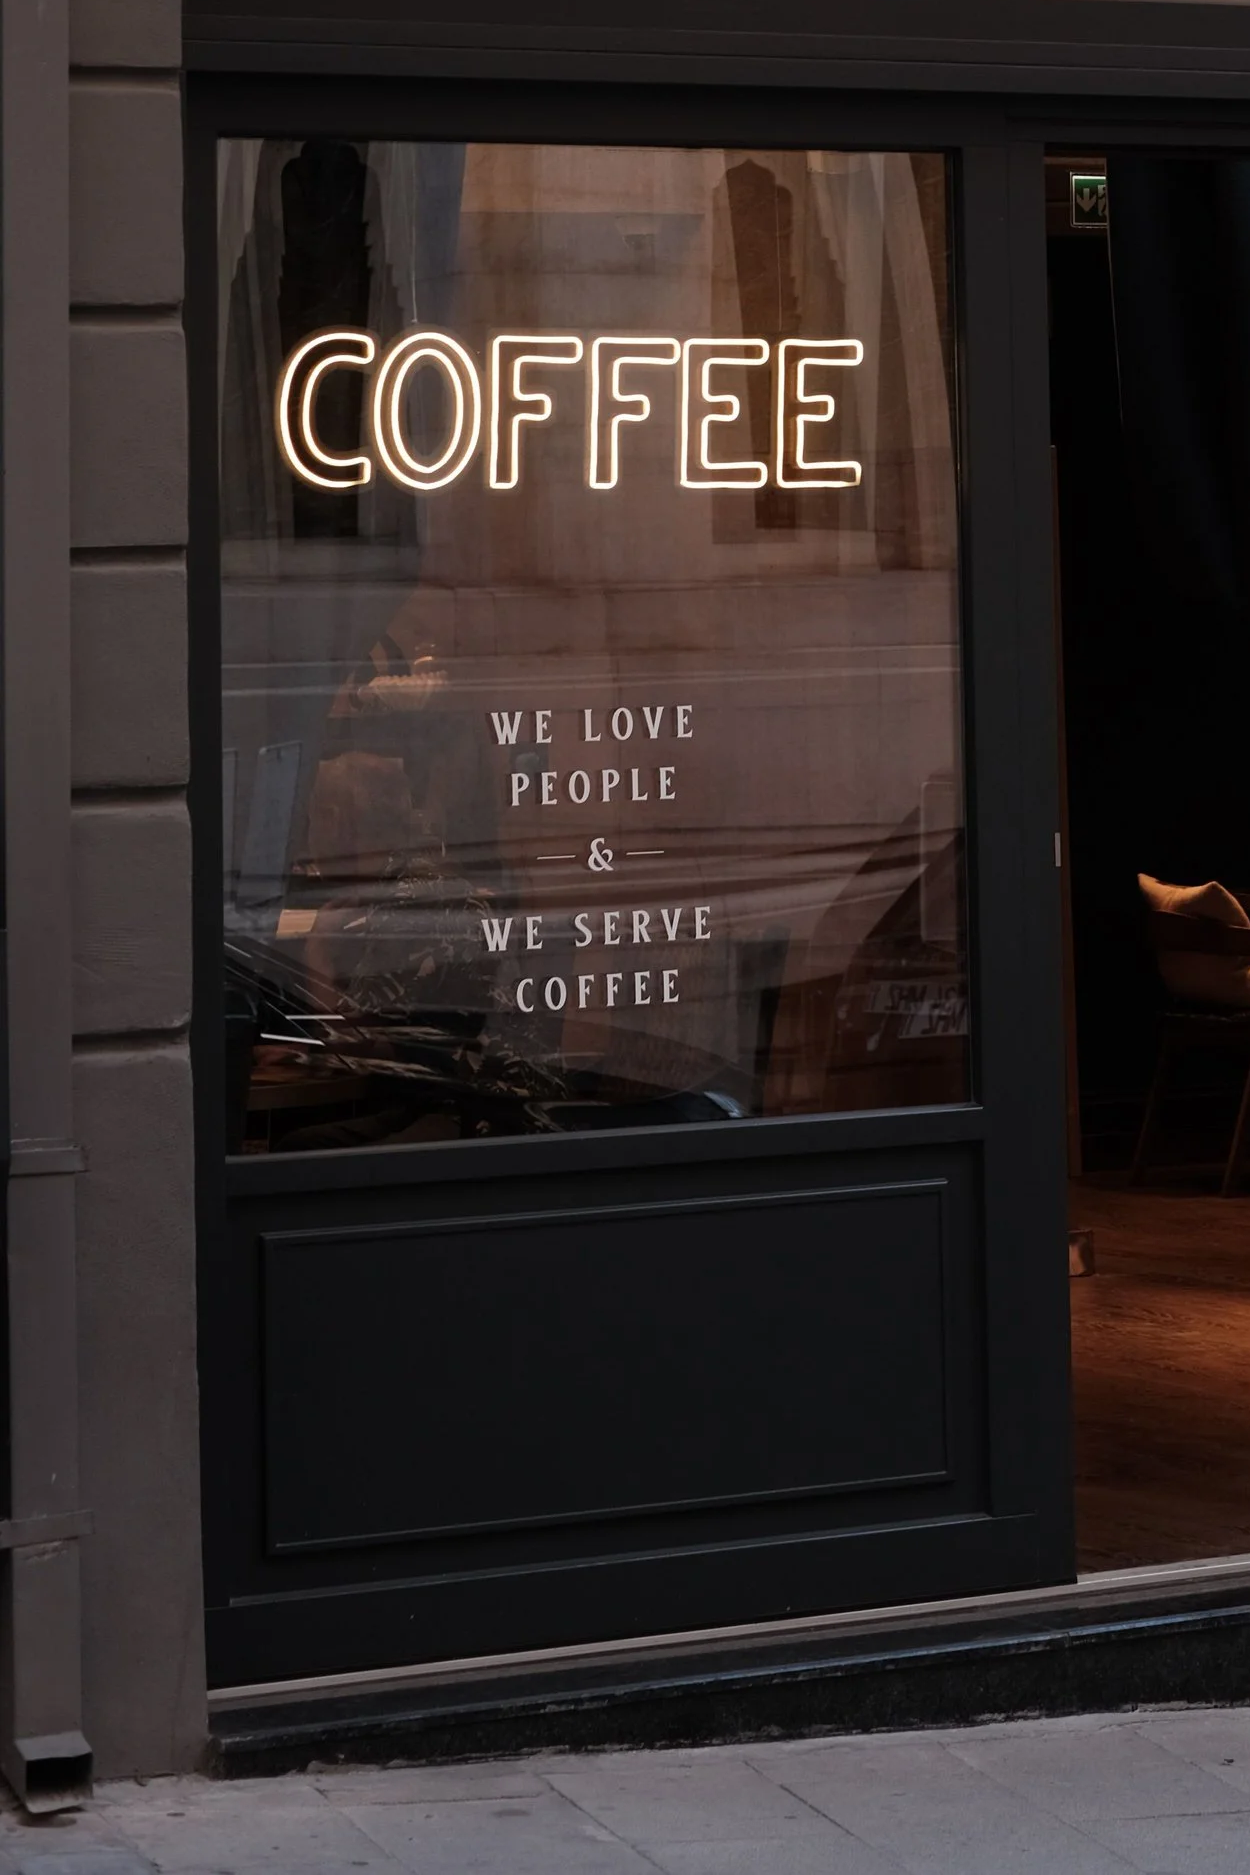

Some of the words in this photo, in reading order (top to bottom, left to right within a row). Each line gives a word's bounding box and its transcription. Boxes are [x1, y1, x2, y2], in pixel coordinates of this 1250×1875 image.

[279, 332, 864, 491] COFFEE
[490, 710, 553, 745] WE
[584, 704, 694, 742] LOVE
[511, 766, 676, 807] PEOPLE
[587, 837, 614, 872] &
[480, 916, 543, 952] WE
[574, 905, 711, 948] SERVE
[516, 969, 680, 1013] COFFEE
